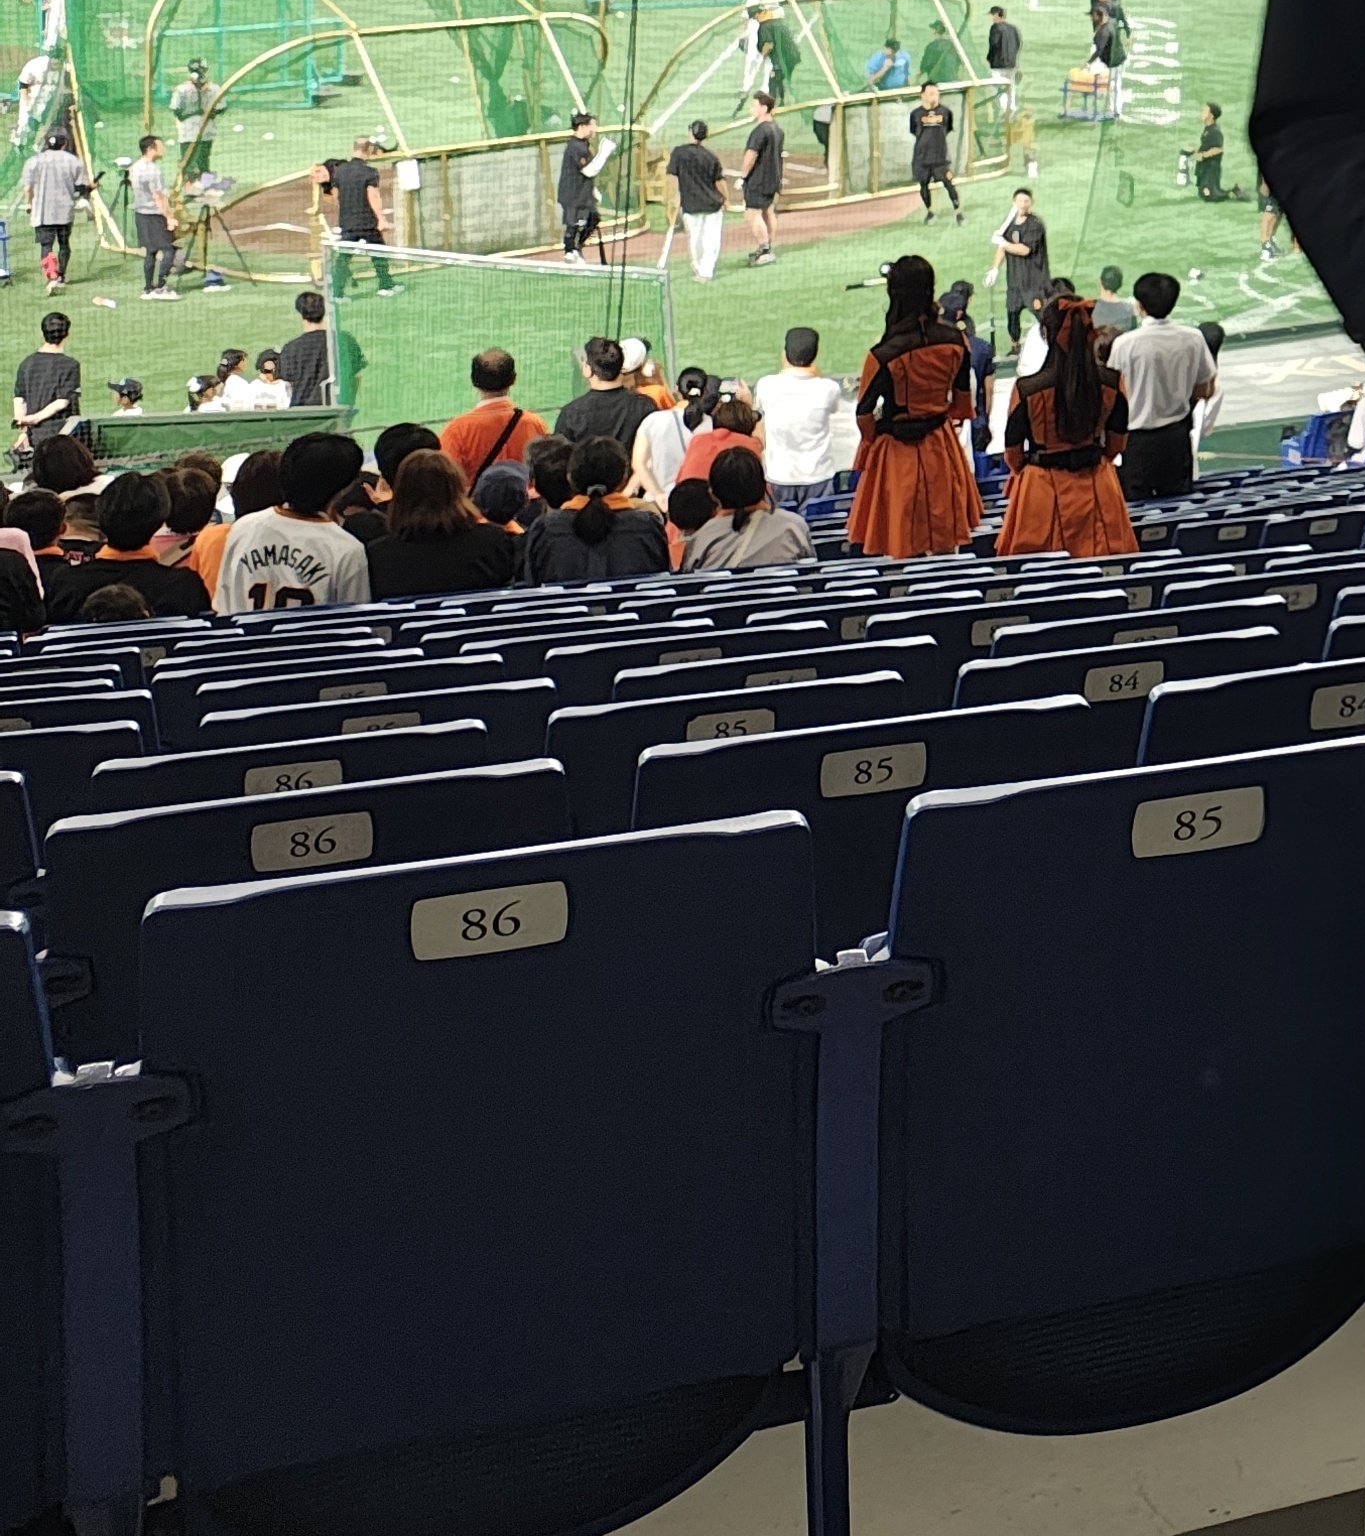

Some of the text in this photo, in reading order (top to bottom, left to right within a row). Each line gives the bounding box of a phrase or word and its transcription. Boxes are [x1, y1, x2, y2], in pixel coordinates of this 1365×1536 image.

[241, 544, 329, 586] YAMASAKI
[1108, 669, 1140, 693] 84
[714, 719, 749, 739] 85
[273, 770, 315, 793] 86
[853, 757, 895, 785] 85
[1172, 805, 1223, 841] 85
[288, 823, 338, 858] 86
[460, 899, 523, 942] 86
